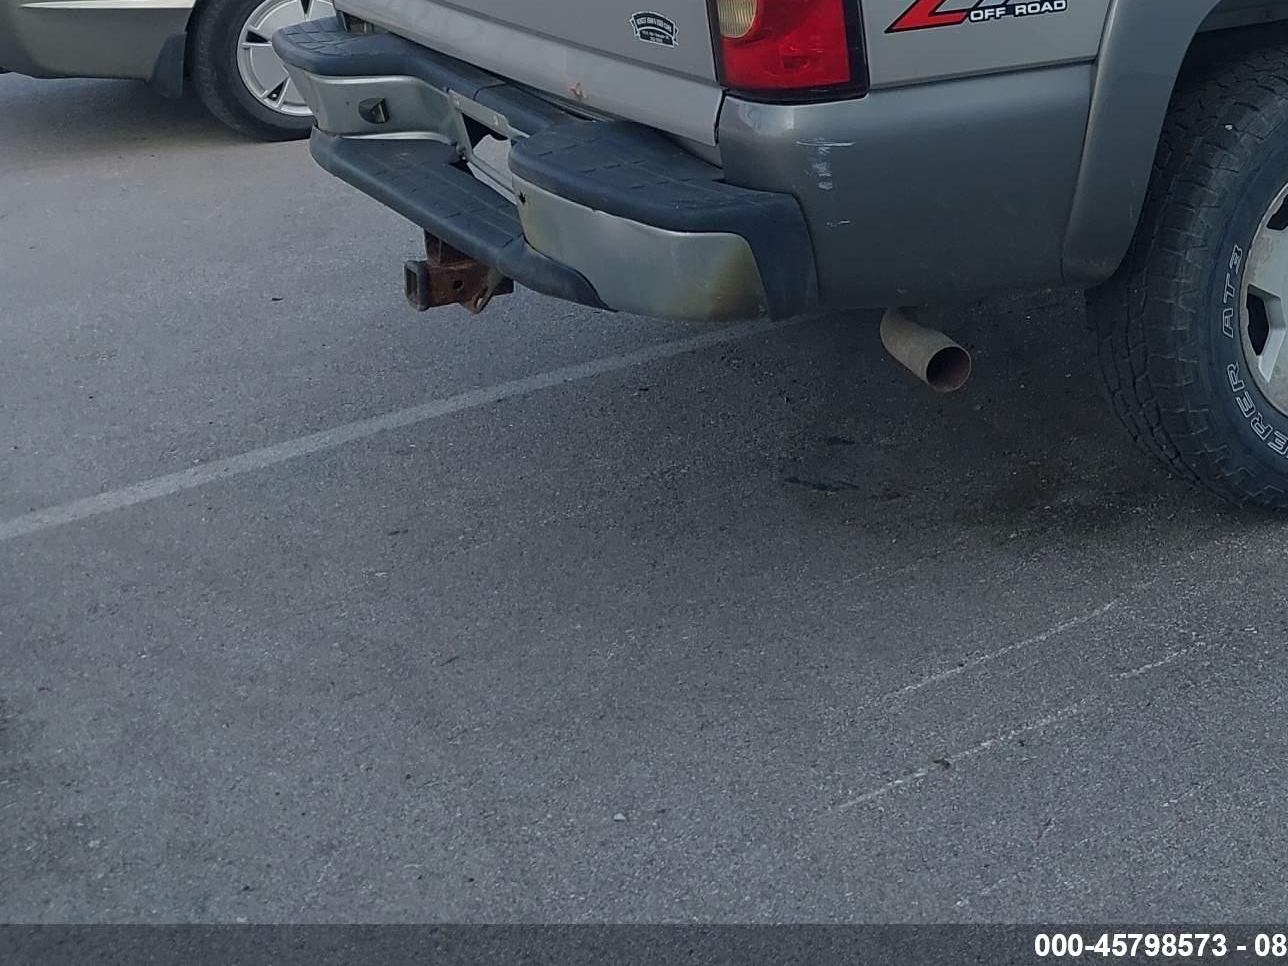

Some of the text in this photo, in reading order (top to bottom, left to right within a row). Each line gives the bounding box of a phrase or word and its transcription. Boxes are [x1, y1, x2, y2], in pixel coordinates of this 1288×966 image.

[969, 0, 1067, 22] OFF ROAD
[1222, 244, 1243, 338] AT3
